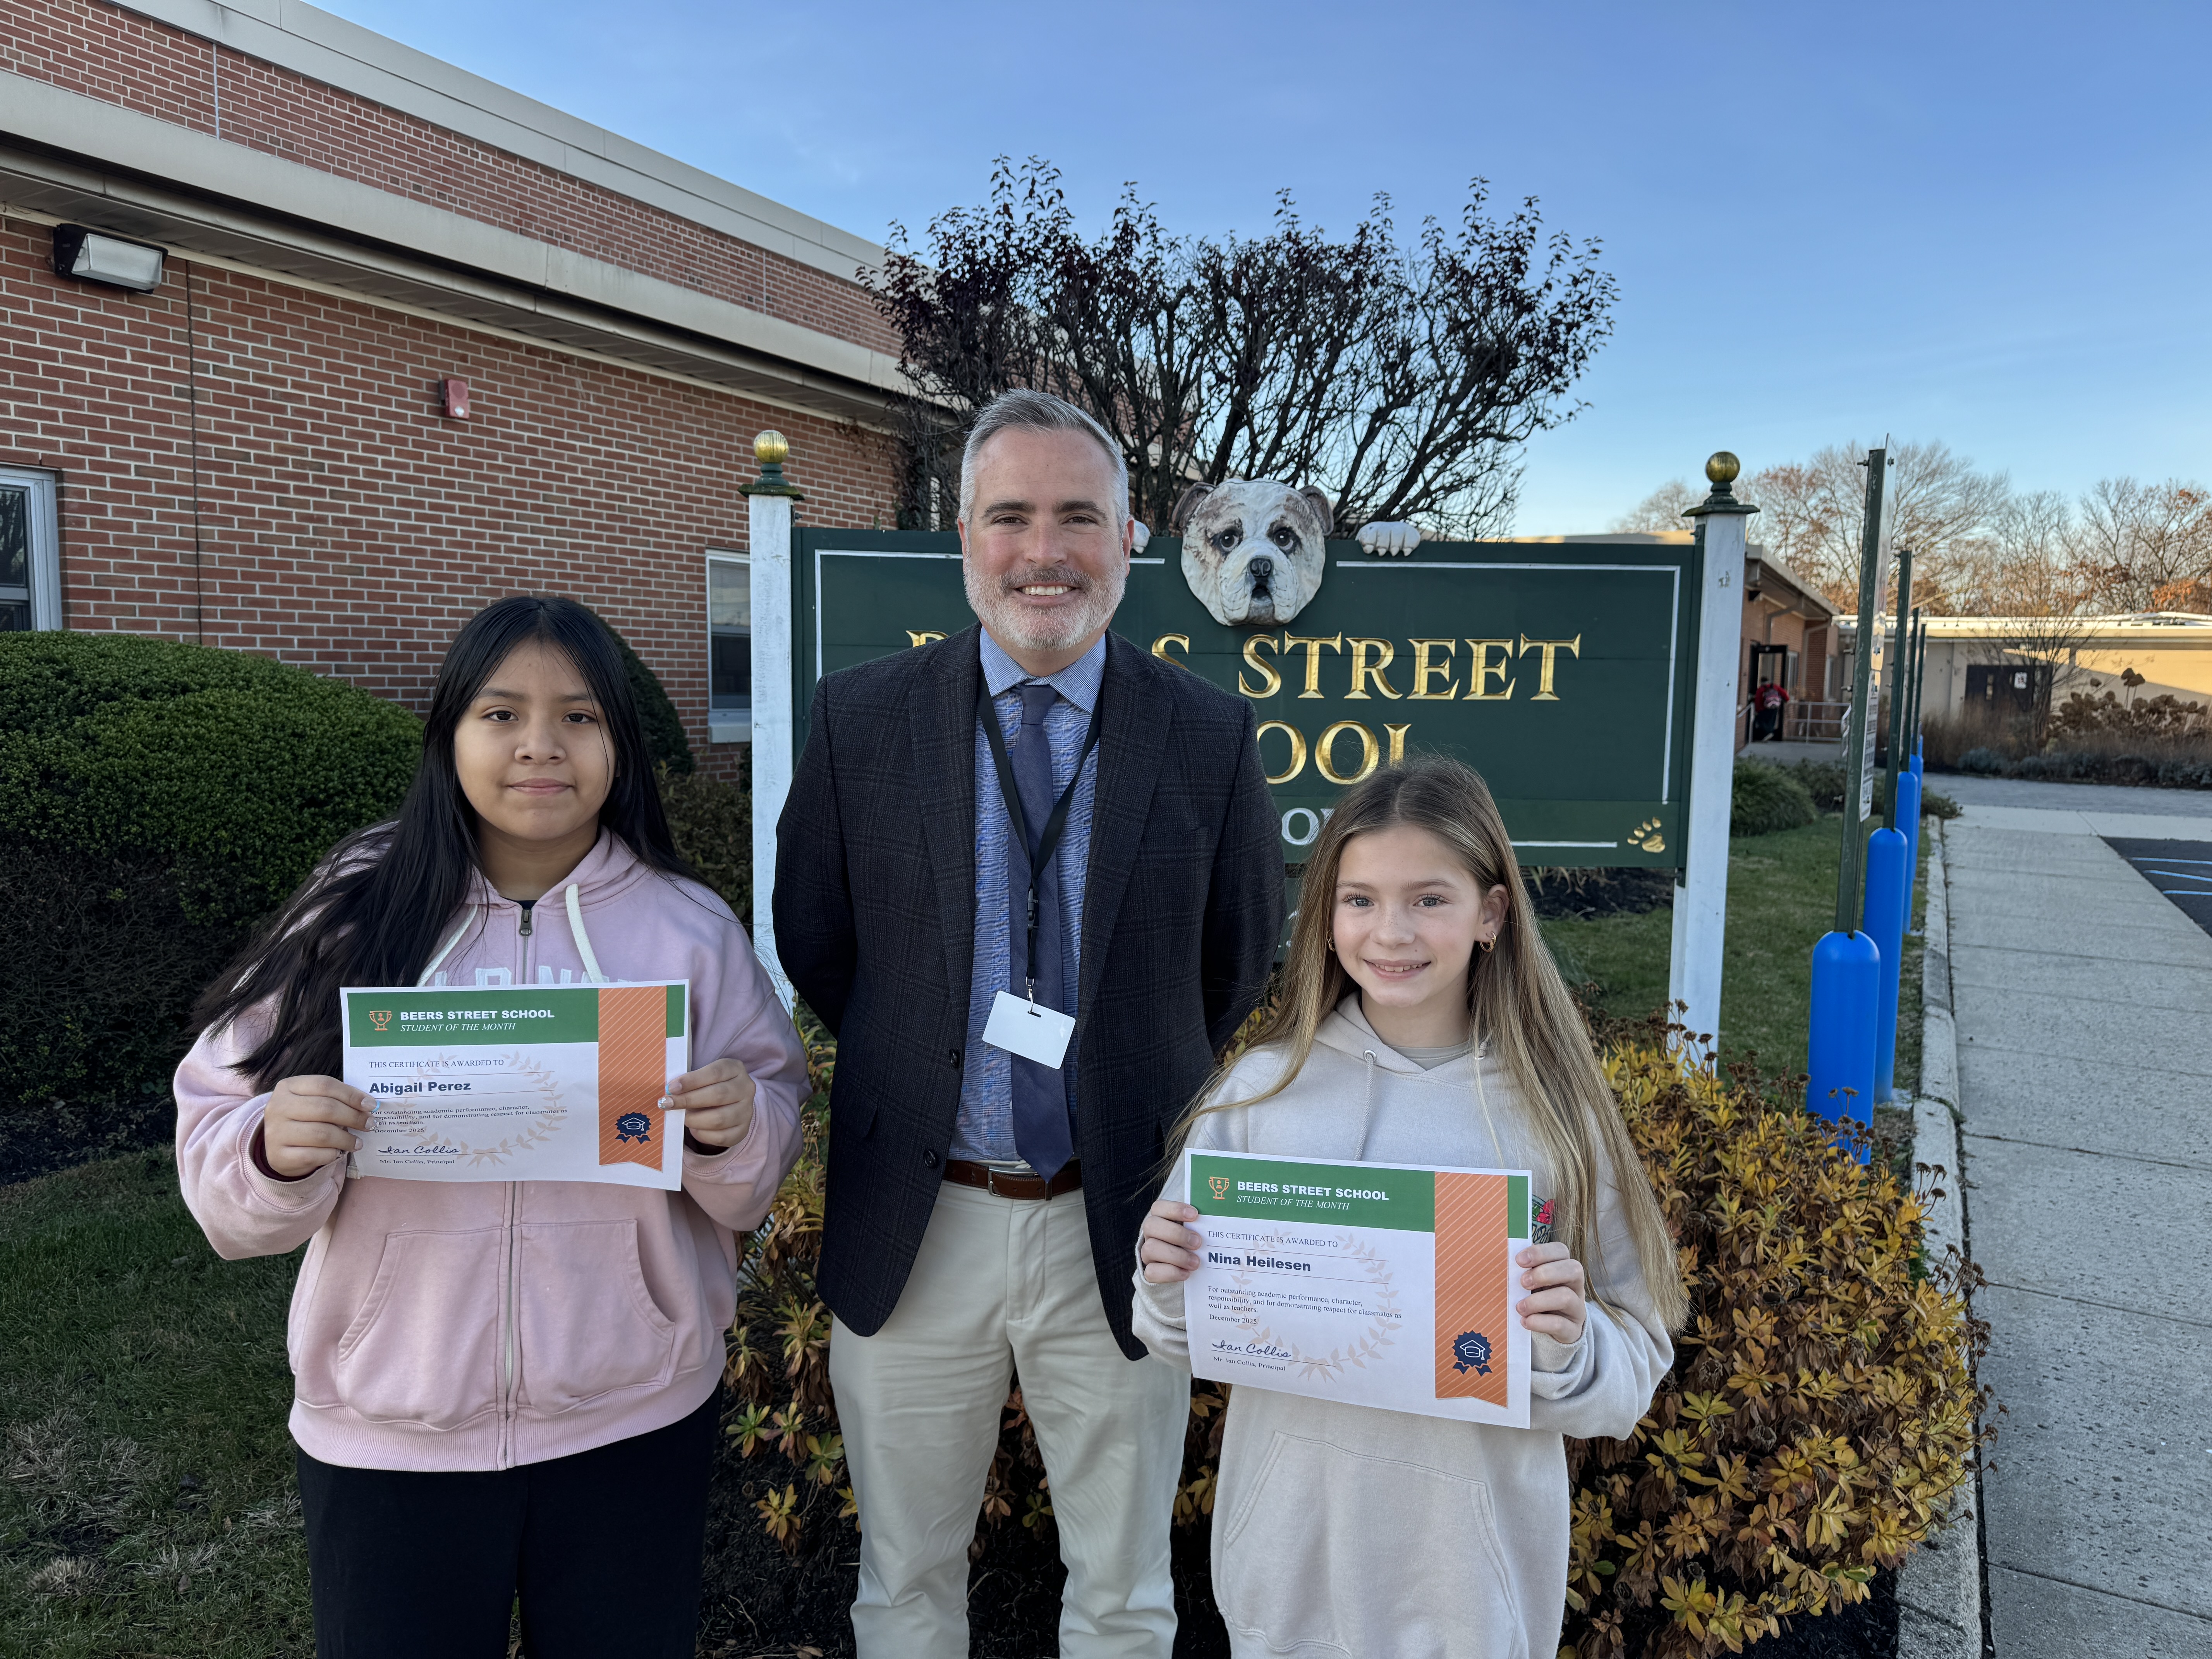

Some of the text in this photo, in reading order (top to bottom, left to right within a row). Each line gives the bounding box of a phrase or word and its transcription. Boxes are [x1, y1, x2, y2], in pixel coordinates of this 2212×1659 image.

[1239, 630, 1581, 701] STREET
[400, 1010, 555, 1020] BEERS STREET SCHOOL
[369, 1082, 471, 1095] Abigail Perez
[378, 1146, 460, 1154] Ian Collis
[1237, 1181, 1389, 1200] BEERS STREET SCHOOL
[1237, 1195, 1279, 1205] STUDENT
[1295, 1199, 1314, 1207] THE
[1316, 1200, 1350, 1210] MONTH
[1226, 1233, 1275, 1242] CERTIFICATE
[1286, 1238, 1325, 1246] AWARDED
[1208, 1252, 1311, 1271] Nina Heilesen
[1220, 1288, 1256, 1297] outstanding
[1289, 1294, 1330, 1304] performance,
[1208, 1295, 1251, 1305] responsibility,
[1277, 1300, 1321, 1312] demonstrating
[1358, 1309, 1393, 1317] classmates
[1209, 1314, 1240, 1322] December
[1212, 1340, 1291, 1357] Ian Collis
[1259, 1363, 1286, 1371] Principal
